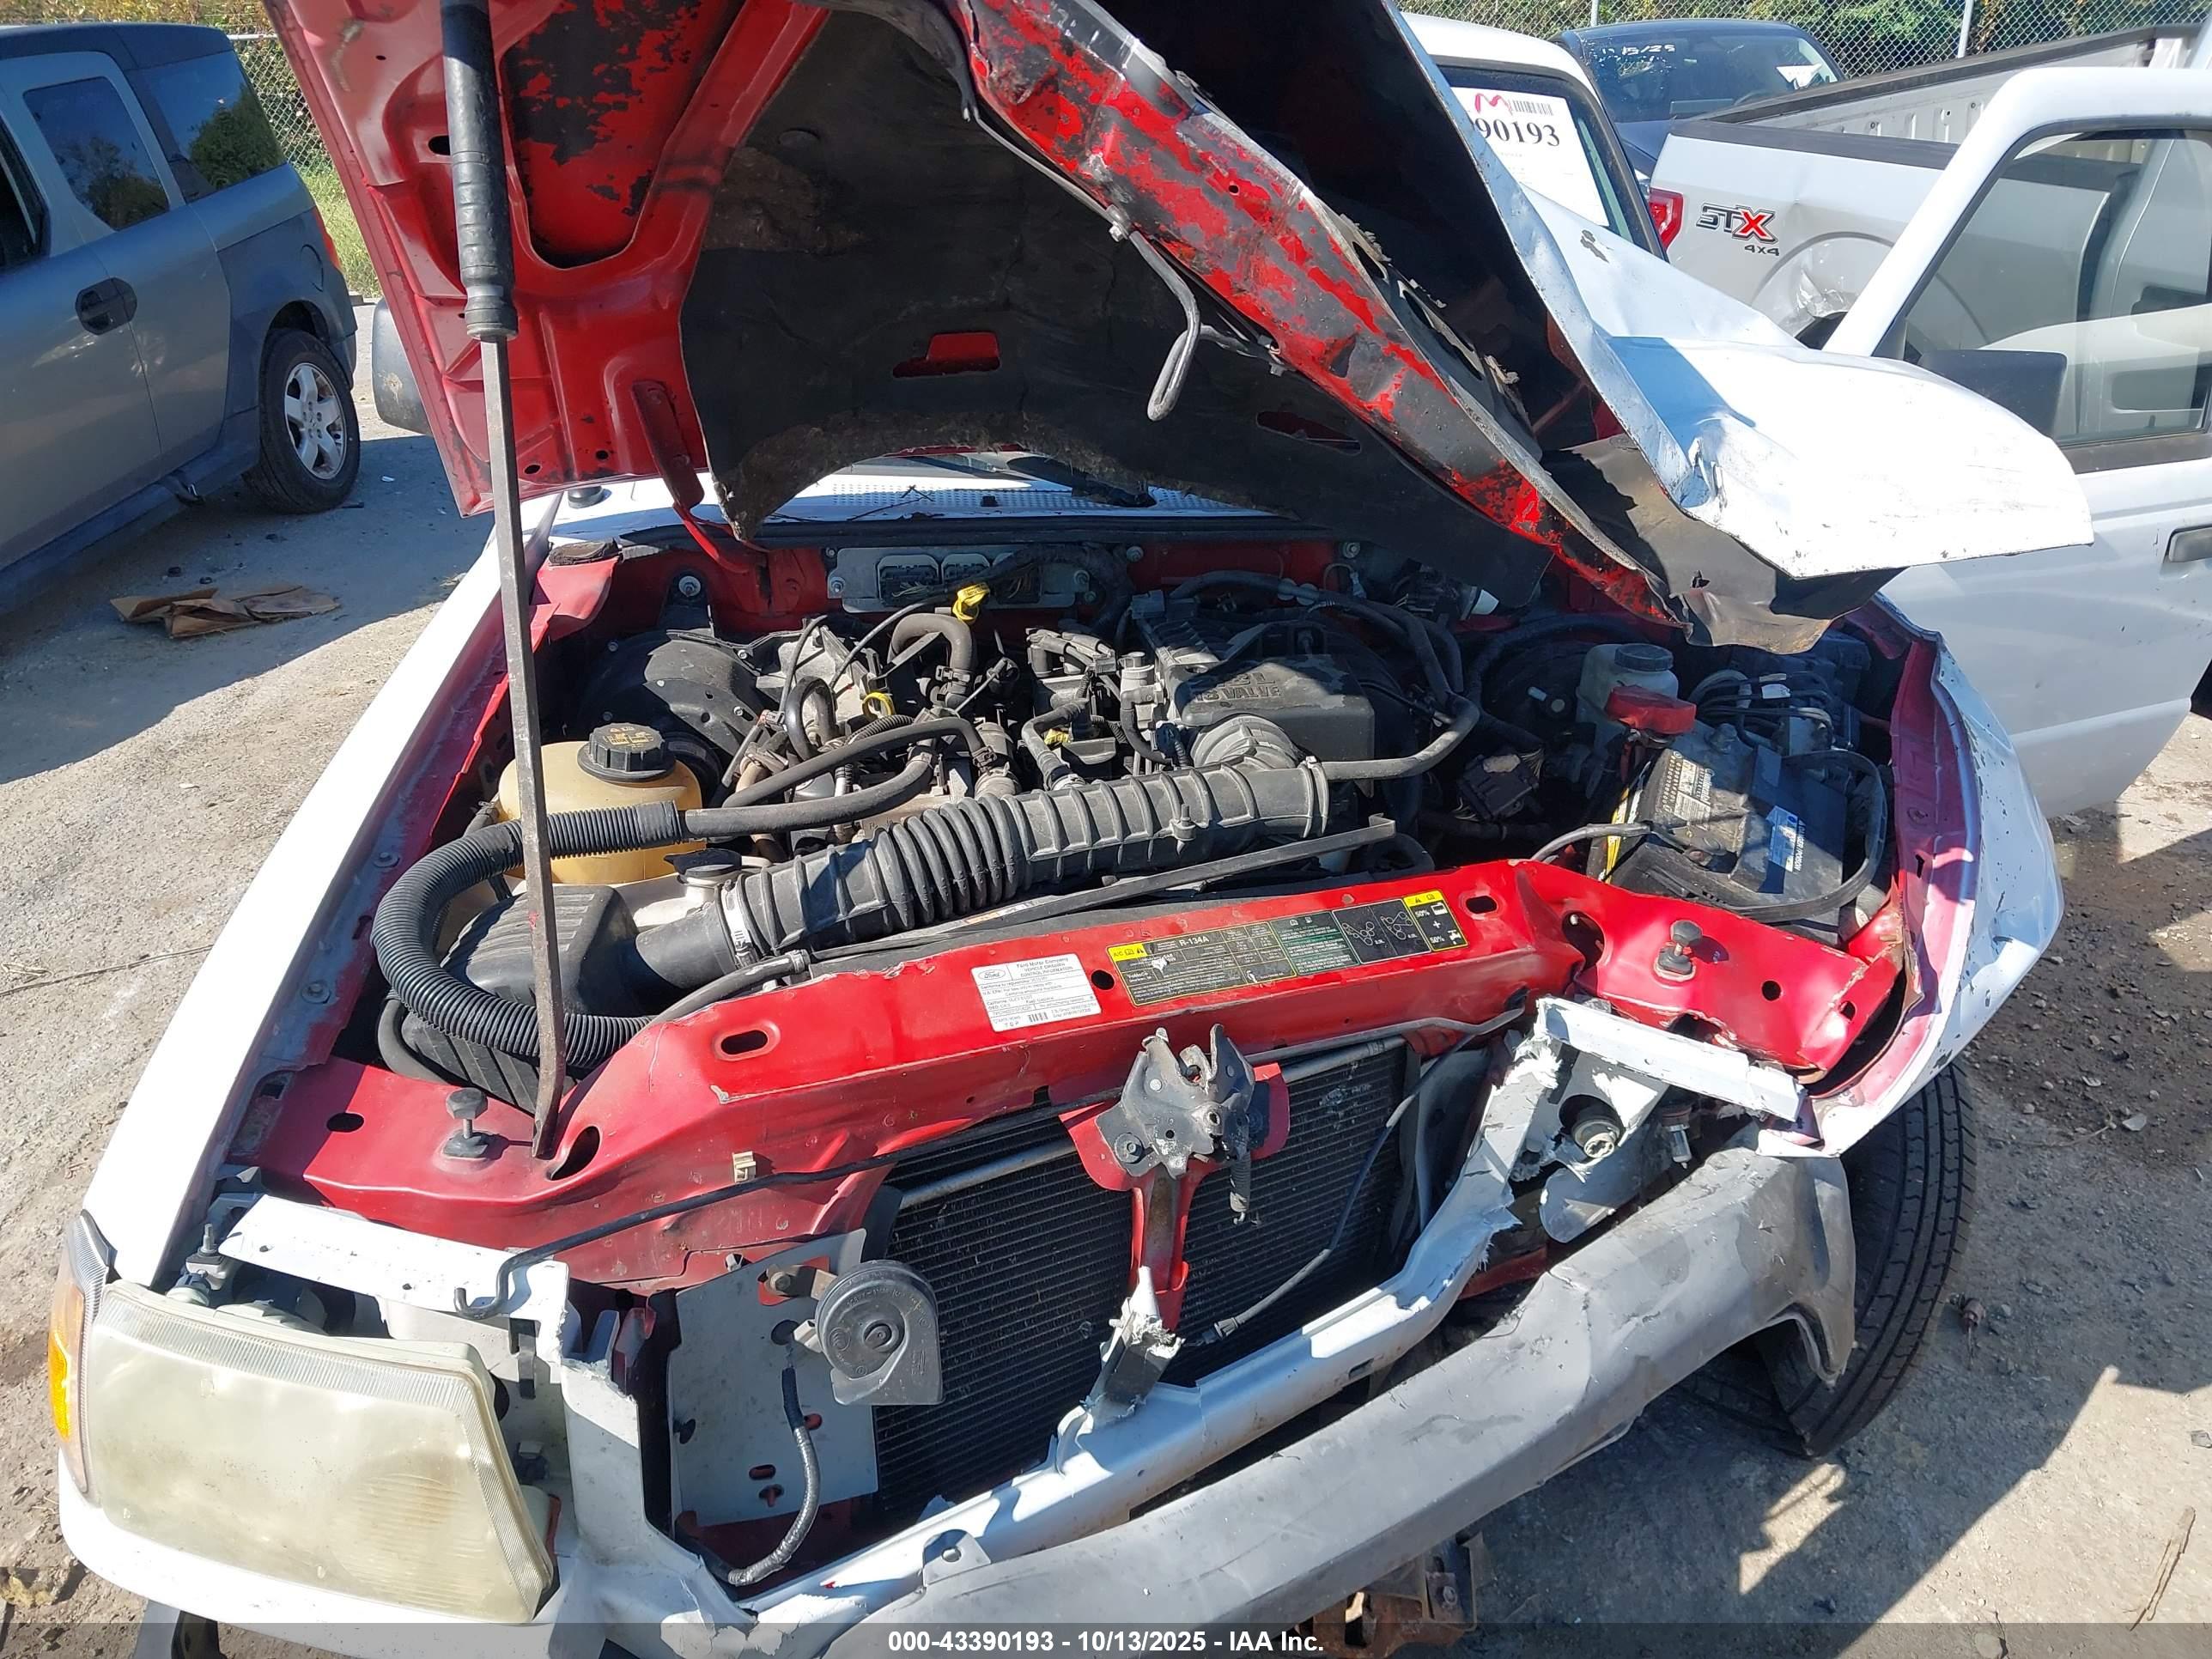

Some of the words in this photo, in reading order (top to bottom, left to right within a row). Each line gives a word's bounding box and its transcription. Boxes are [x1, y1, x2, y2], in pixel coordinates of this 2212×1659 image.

[1474, 118, 1560, 147] 90193
[1696, 203, 1778, 244] STX
[1221, 686, 1281, 701] VALVE
[1415, 908, 1431, 918] 50%
[1179, 936, 1210, 947] R-134A
[1429, 935, 1445, 944] 50%
[983, 969, 1000, 978] Ford
